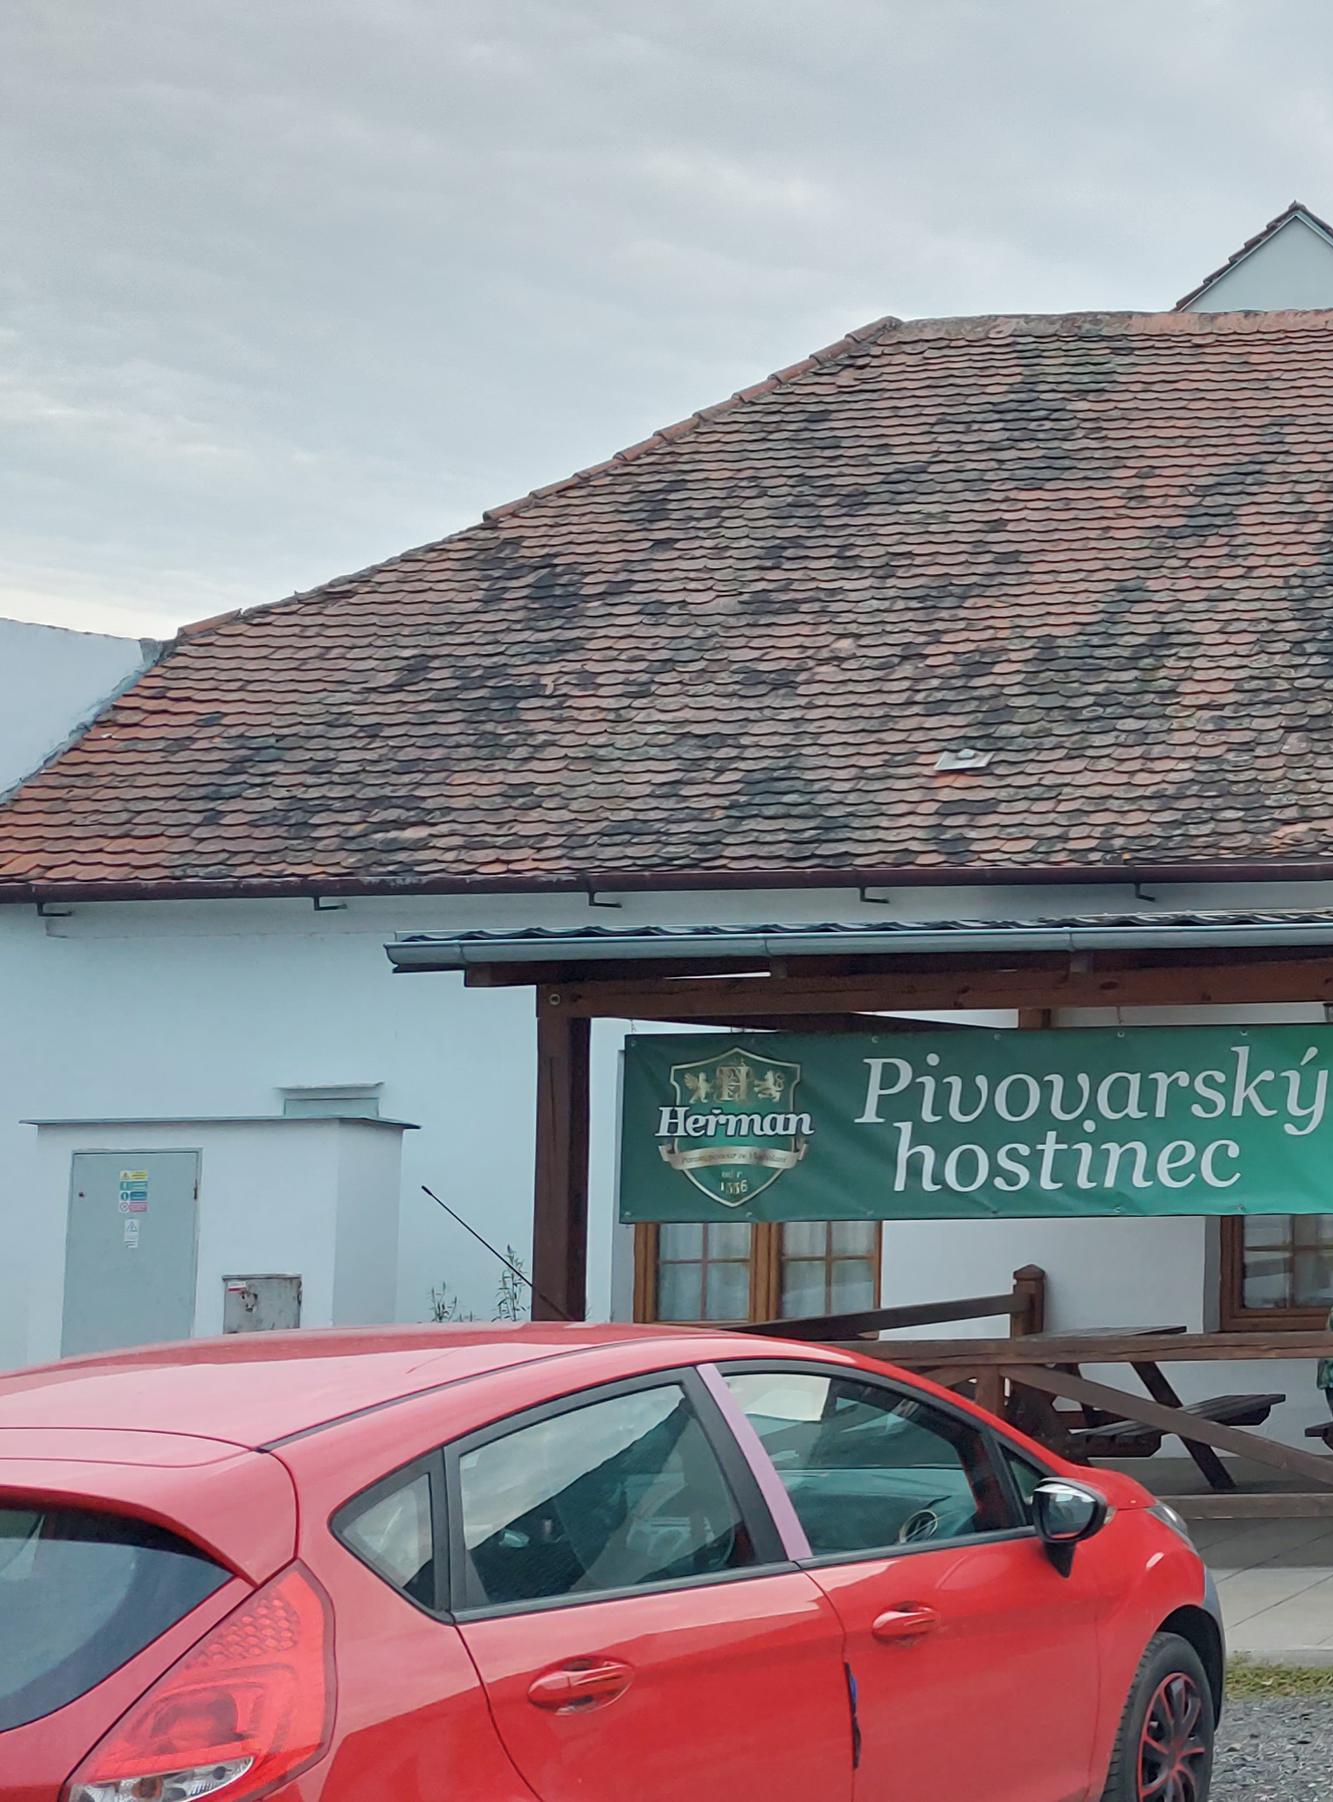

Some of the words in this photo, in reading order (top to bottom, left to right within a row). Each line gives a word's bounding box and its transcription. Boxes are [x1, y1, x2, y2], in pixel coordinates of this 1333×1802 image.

[655, 1106, 815, 1137] Heřman
[854, 1045, 1329, 1136] Pivovarský
[892, 1120, 1242, 1192] hostinec
